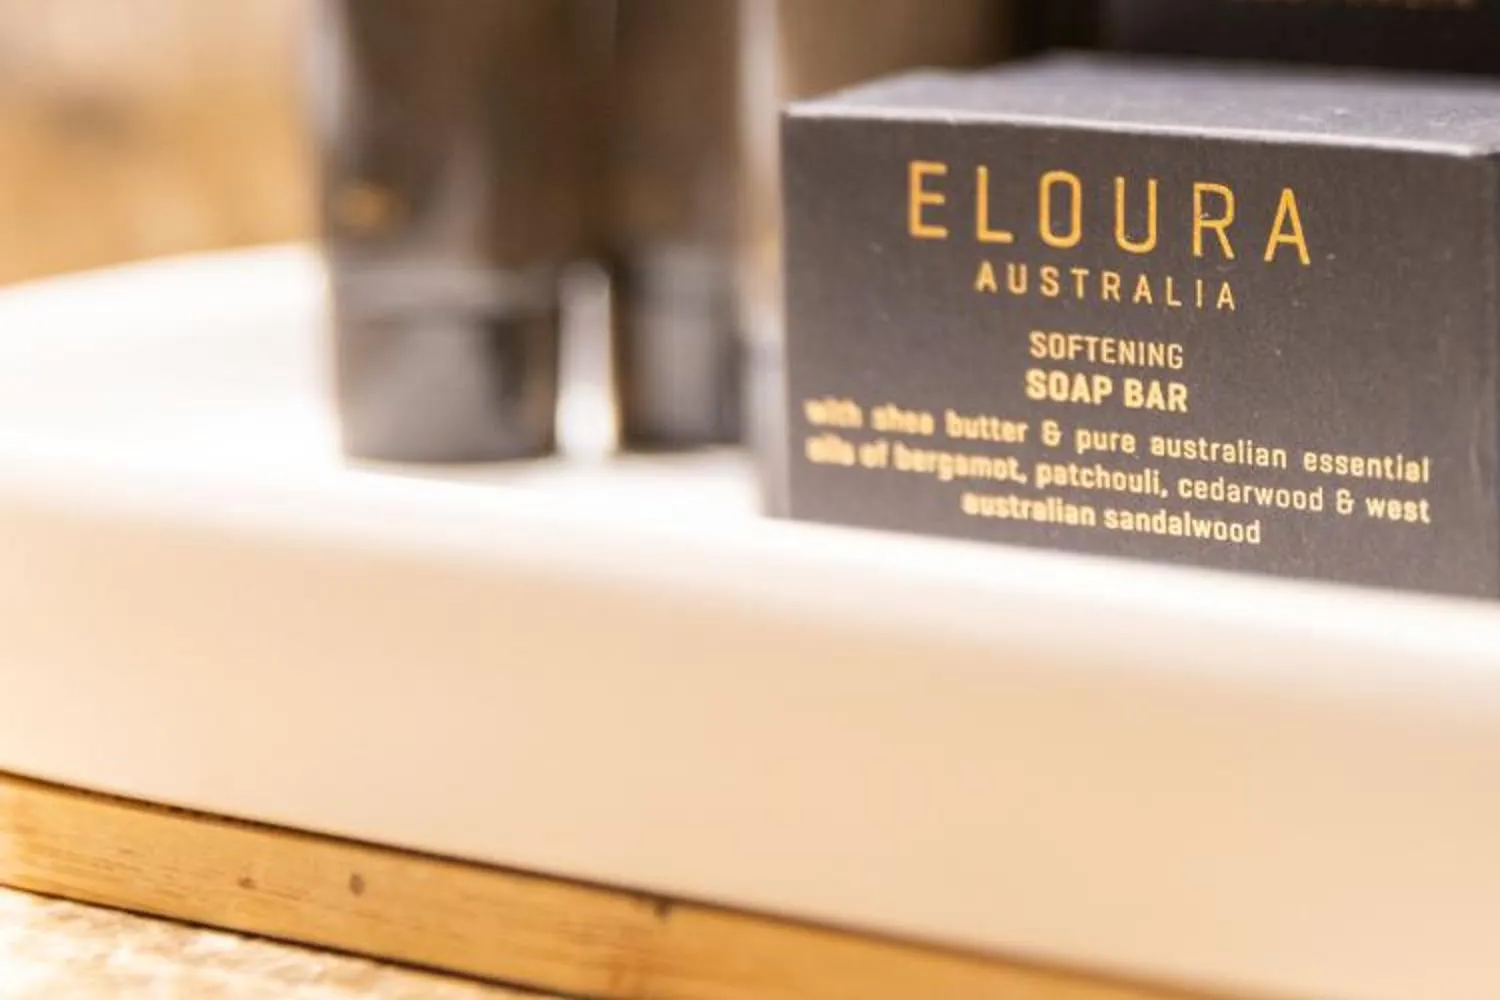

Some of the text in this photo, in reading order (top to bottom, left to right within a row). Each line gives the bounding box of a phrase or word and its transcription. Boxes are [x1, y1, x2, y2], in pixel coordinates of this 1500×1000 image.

[906, 159, 1312, 266] ELOURA
[975, 260, 1237, 311] AUSTRALIA
[1028, 330, 1185, 370] SOFTENING
[1025, 368, 1189, 413] SOAP BAR
[870, 401, 936, 436] shea
[944, 407, 1029, 444] butter
[1041, 419, 1062, 447] &
[1076, 428, 1137, 455] pure
[1150, 432, 1288, 470] australian
[1303, 452, 1431, 484] essential
[859, 440, 889, 469] of
[892, 441, 1028, 483] bergamot,
[1035, 463, 1169, 499] patchouli,
[1177, 476, 1324, 512] cedarwood
[1335, 490, 1356, 516] &
[1365, 496, 1432, 524] west
[961, 491, 1262, 545] australian sandalwood
